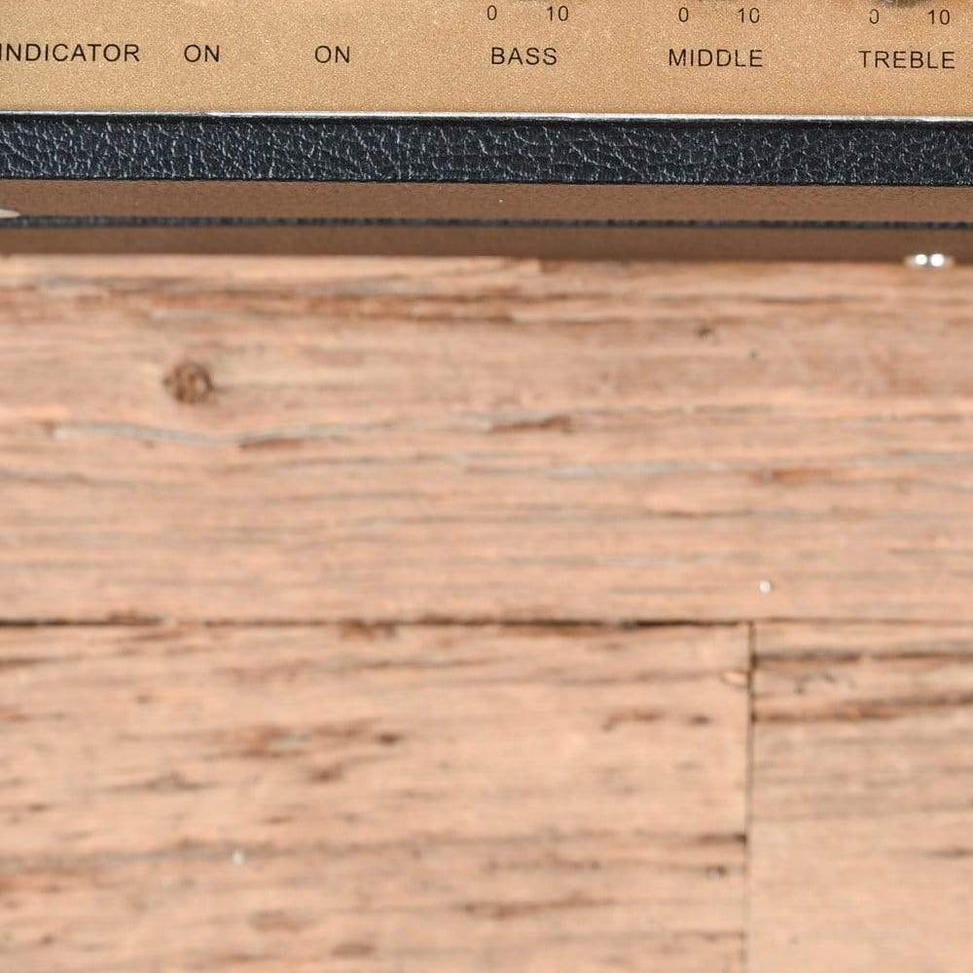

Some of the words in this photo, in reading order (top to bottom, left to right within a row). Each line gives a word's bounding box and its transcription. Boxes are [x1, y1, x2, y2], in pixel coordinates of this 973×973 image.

[487, 4, 498, 21] 0
[546, 4, 569, 22] 10
[678, 6, 689, 23] 0
[738, 7, 760, 24] 10
[869, 8, 880, 25] 0
[928, 9, 950, 26] 10
[0, 43, 140, 62] INDICATOR
[184, 45, 220, 63] ON
[314, 46, 350, 64] ON
[491, 47, 557, 66] BASS
[668, 49, 763, 68] MIDDLE
[859, 50, 955, 69] TREBLE
